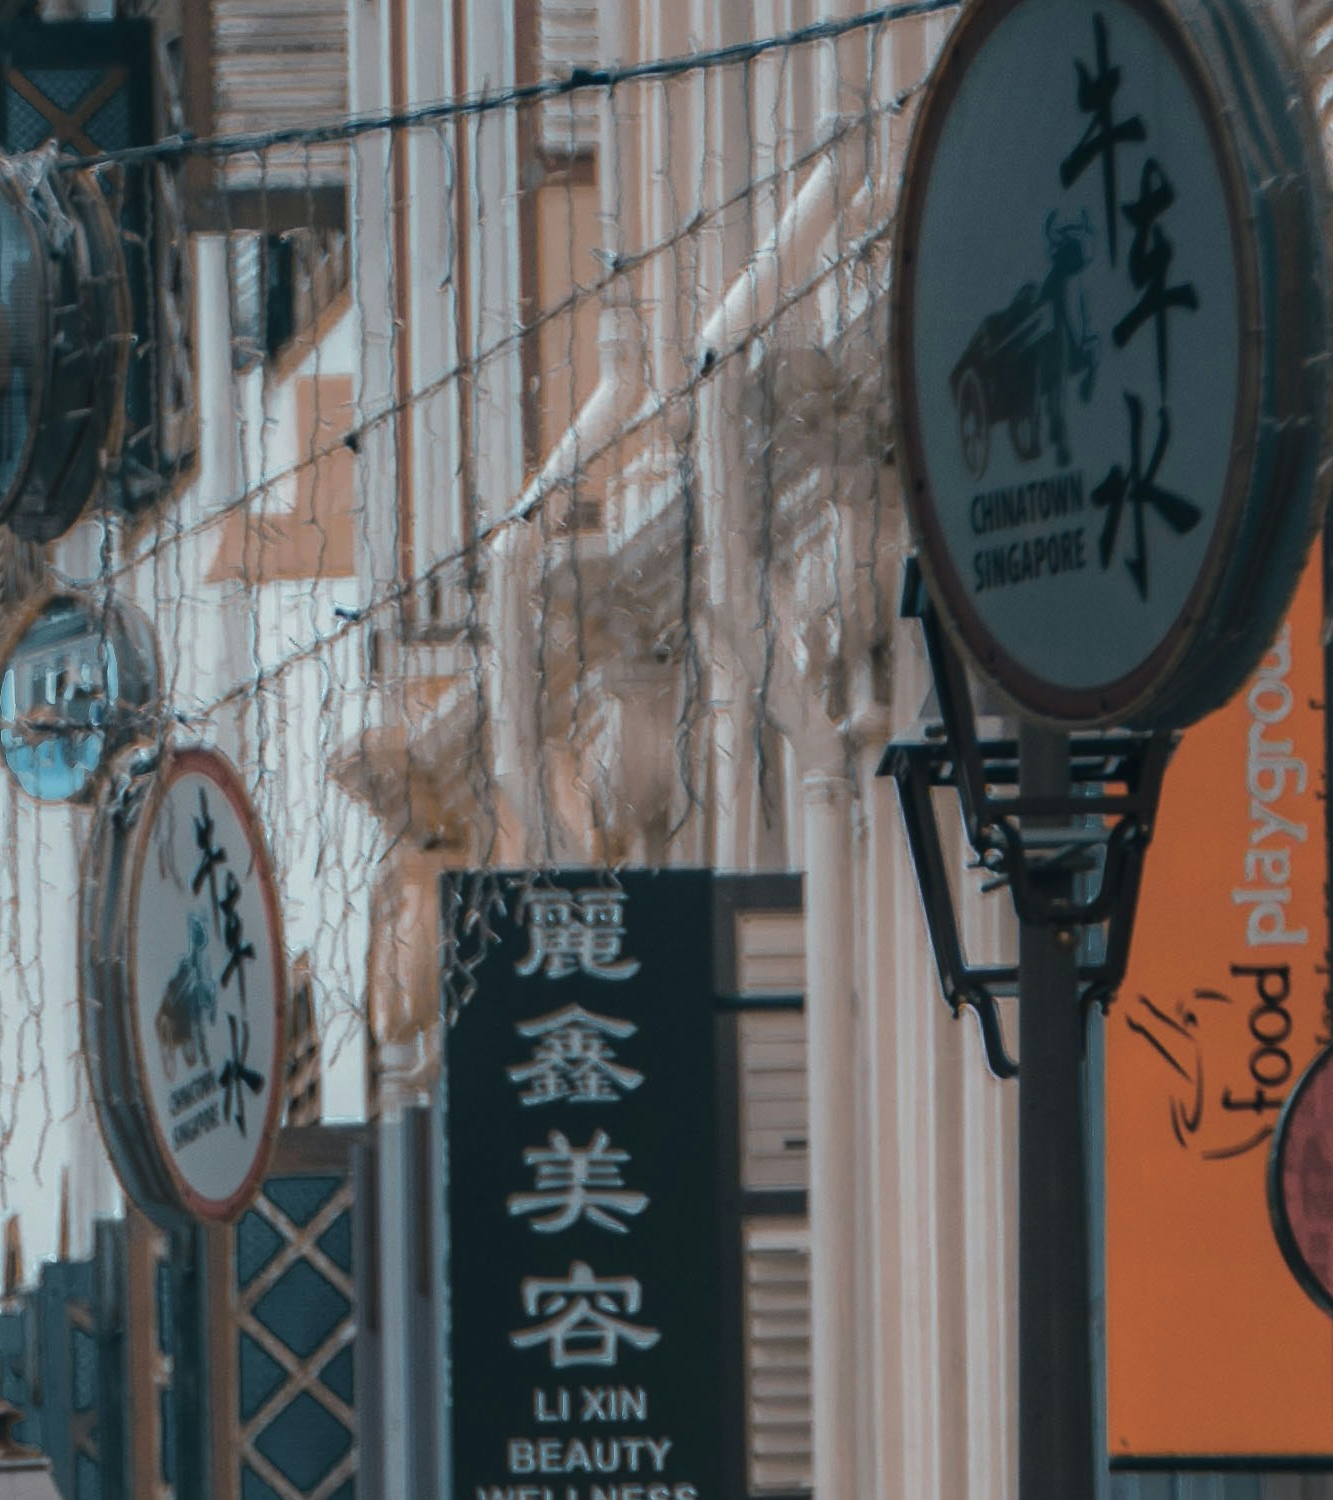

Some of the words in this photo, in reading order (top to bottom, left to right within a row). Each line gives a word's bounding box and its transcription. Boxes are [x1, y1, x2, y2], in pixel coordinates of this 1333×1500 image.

[970, 469, 1084, 535] CHINATOWN
[974, 526, 1087, 592] SINGAPORE
[1233, 619, 1308, 946] playgrou
[1222, 961, 1291, 1114] food
[506, 886, 661, 1368] 麗鑫美容
[534, 1386, 571, 1422] LI
[580, 1386, 648, 1422] XIN
[507, 1436, 673, 1474] BEAUTY
